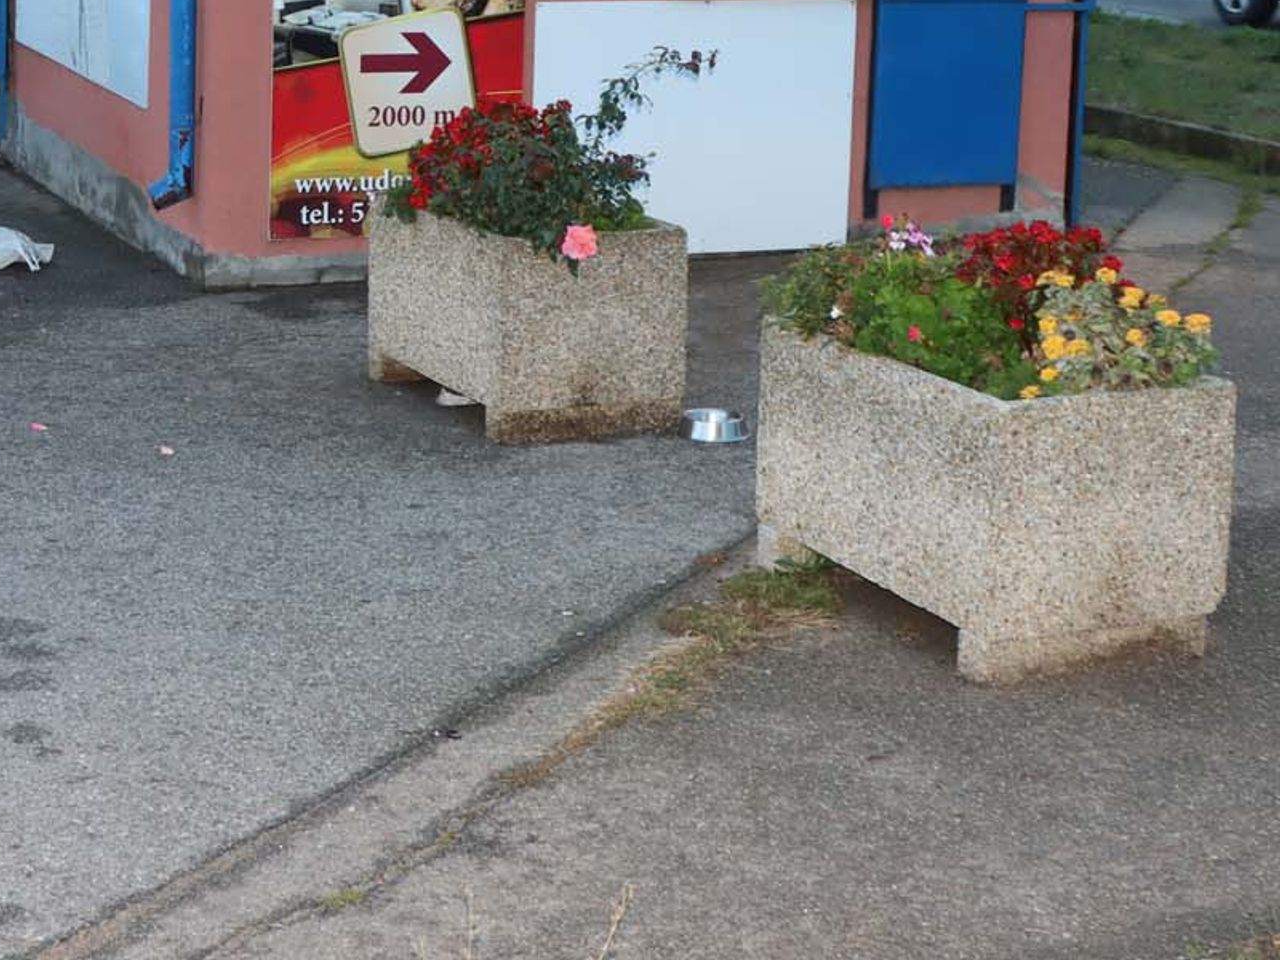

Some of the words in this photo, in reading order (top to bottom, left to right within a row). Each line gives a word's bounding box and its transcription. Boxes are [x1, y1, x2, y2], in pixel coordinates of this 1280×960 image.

[368, 106, 425, 127] 2000
[295, 169, 412, 193] www.udo
[301, 201, 344, 225] tel.:
